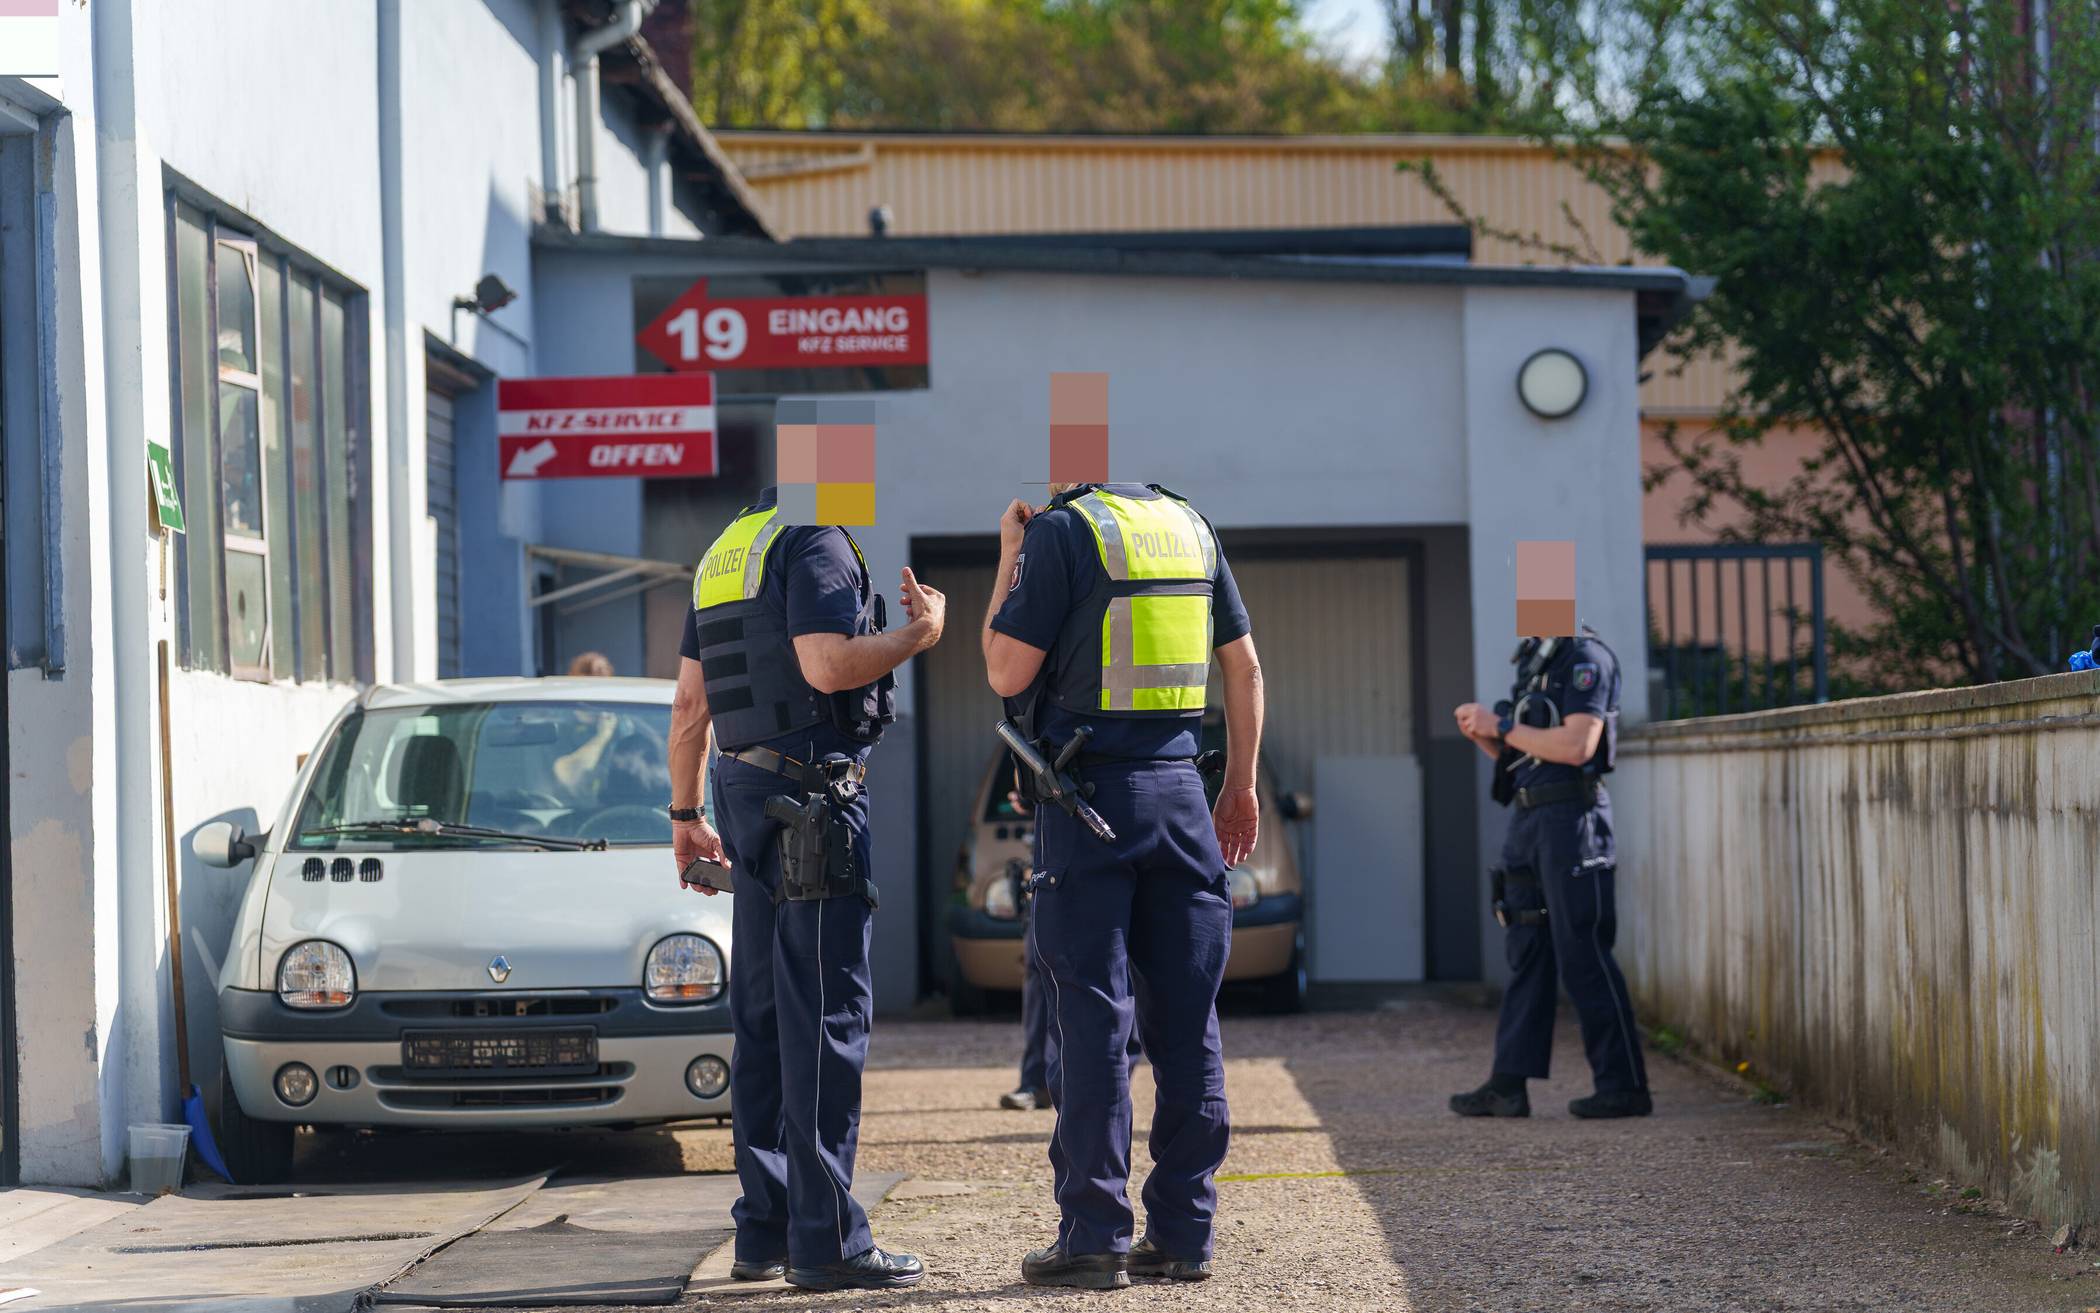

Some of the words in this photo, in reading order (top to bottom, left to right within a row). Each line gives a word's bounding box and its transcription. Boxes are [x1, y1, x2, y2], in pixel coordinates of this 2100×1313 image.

[768, 306, 909, 335] EINGANG
[666, 308, 748, 361] 19
[798, 336, 833, 353] KFZ
[835, 335, 909, 353] SERVICE
[527, 412, 684, 430] KFZ-SERVICE
[588, 443, 685, 467] OFFEN
[704, 547, 745, 581] POLIZEI
